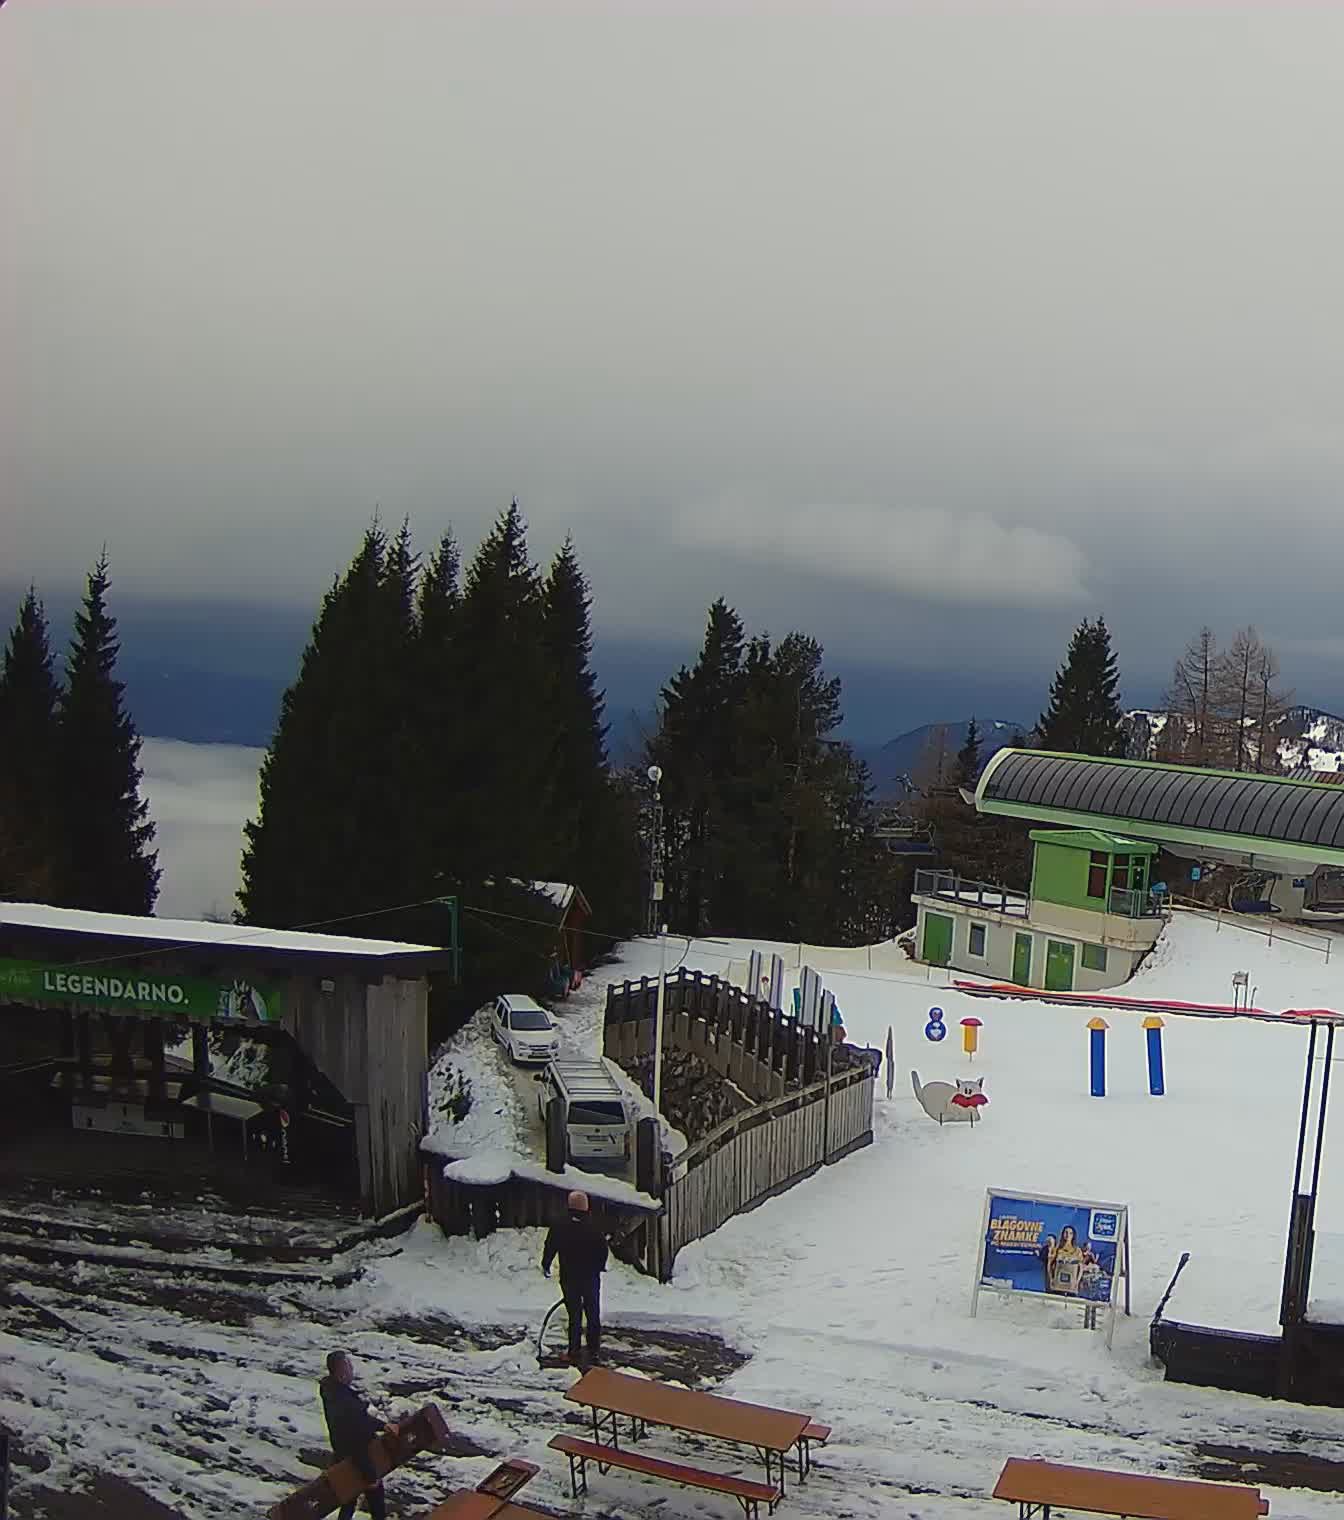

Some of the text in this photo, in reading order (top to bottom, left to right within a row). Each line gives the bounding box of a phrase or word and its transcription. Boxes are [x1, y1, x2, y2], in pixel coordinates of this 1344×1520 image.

[43, 970, 190, 1005] LEGENDARNO.
[991, 1219, 1044, 1232] BLAGOVNE
[993, 1230, 1039, 1242] ZNAMKE
